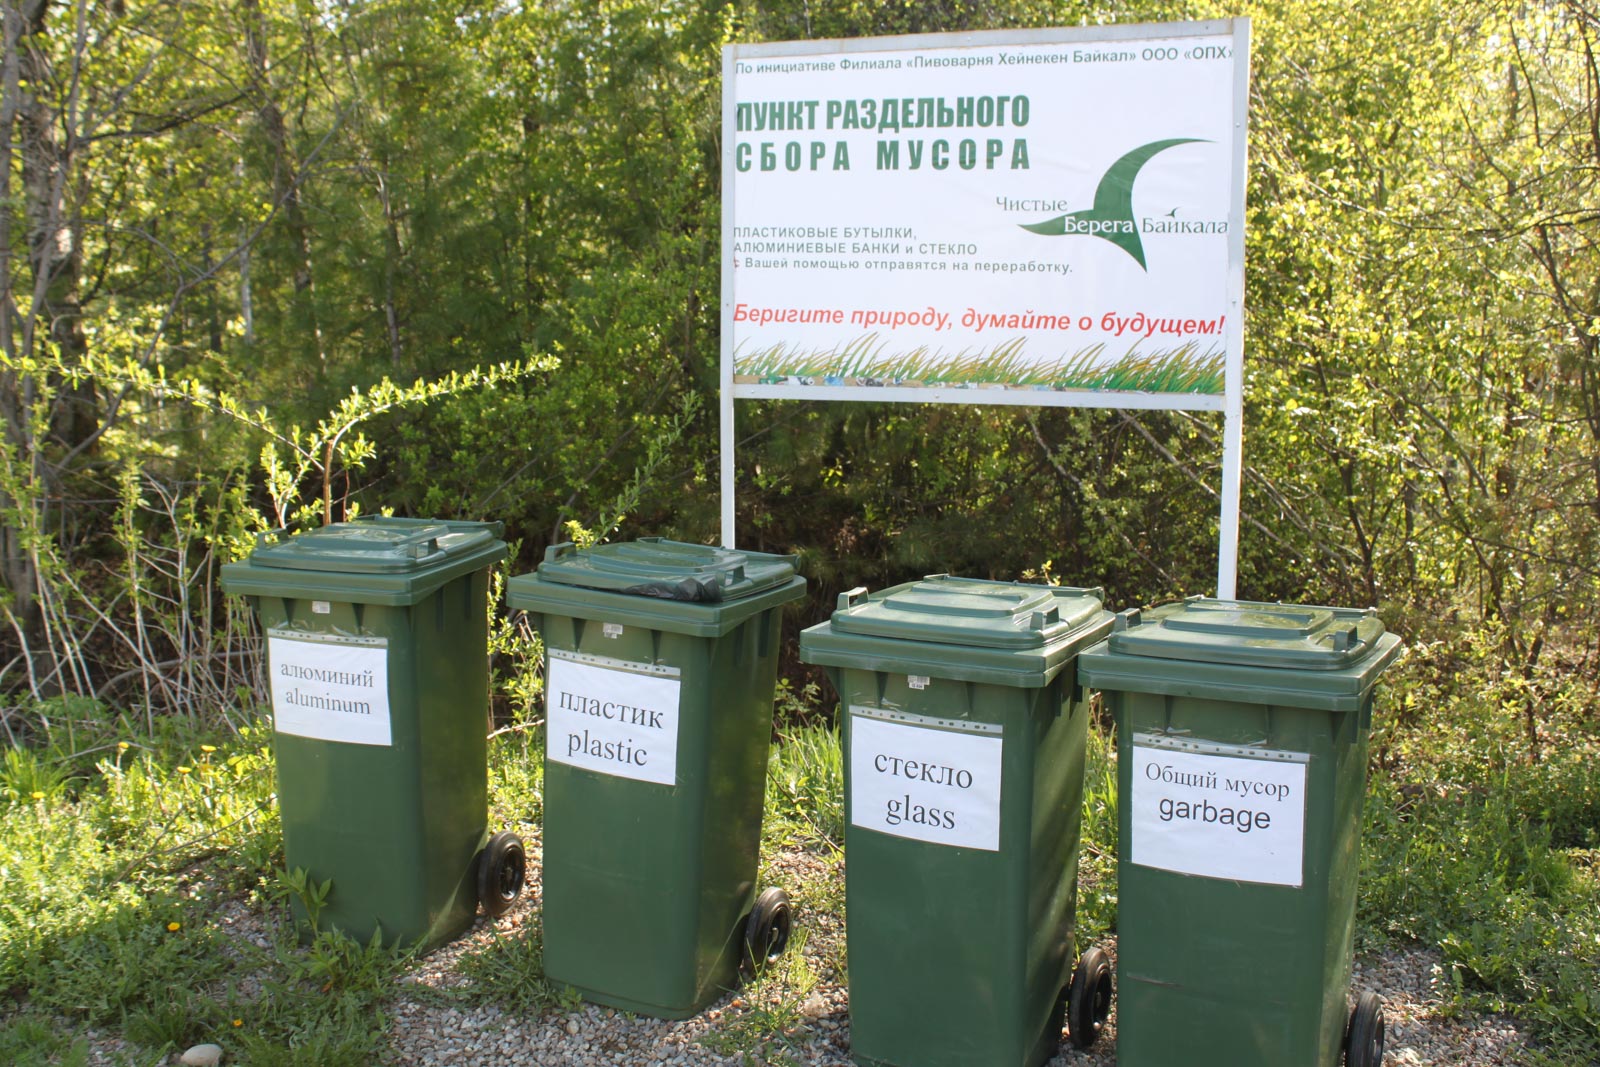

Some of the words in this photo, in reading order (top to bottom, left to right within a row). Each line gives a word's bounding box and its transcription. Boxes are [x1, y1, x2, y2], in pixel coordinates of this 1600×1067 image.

[736, 63, 752, 74] По
[756, 60, 835, 74] инициативе
[840, 58, 902, 70] Филиала
[907, 55, 993, 69] «Пивоварня
[998, 52, 1068, 65] Хейнекен
[1073, 49, 1136, 62] Байкал»
[1142, 48, 1178, 60] ООО
[736, 100, 819, 132] ПУНКТ
[826, 95, 1030, 134] РАЗДЕЛЬНОГО
[735, 140, 850, 172] СБОРА
[876, 138, 1030, 171] МУСОРА
[996, 197, 1068, 212] Чистые
[733, 226, 838, 239] ПЛАСТИКОВЫЕ
[843, 227, 917, 240] БУТЫЛКИ,
[1064, 216, 1134, 236] Берега
[1142, 209, 1228, 235] Байкала
[733, 242, 847, 255] АЛЮМИНИЕВЫЕ
[852, 242, 900, 255] БАНКИ
[905, 245, 914, 255] и
[919, 243, 978, 256] СТЕКЛО
[745, 257, 788, 268] Вашей
[793, 259, 860, 272] помощью
[864, 260, 947, 272] отправятся
[952, 261, 969, 271] на
[974, 260, 1073, 275] переработку.
[733, 303, 845, 326] Беригите
[850, 306, 953, 331] природу,
[961, 308, 1071, 332] думайте
[1078, 315, 1093, 331] о
[1100, 311, 1226, 337] будущем!
[280, 662, 374, 688] алюминий
[285, 688, 371, 715] aluminum
[559, 690, 664, 730] пластик
[568, 729, 648, 767] plastic
[874, 754, 974, 790] стекло
[1145, 762, 1218, 790] Общий
[1225, 778, 1290, 802] мусор
[885, 794, 956, 831] glass
[1159, 798, 1272, 833] garbage
